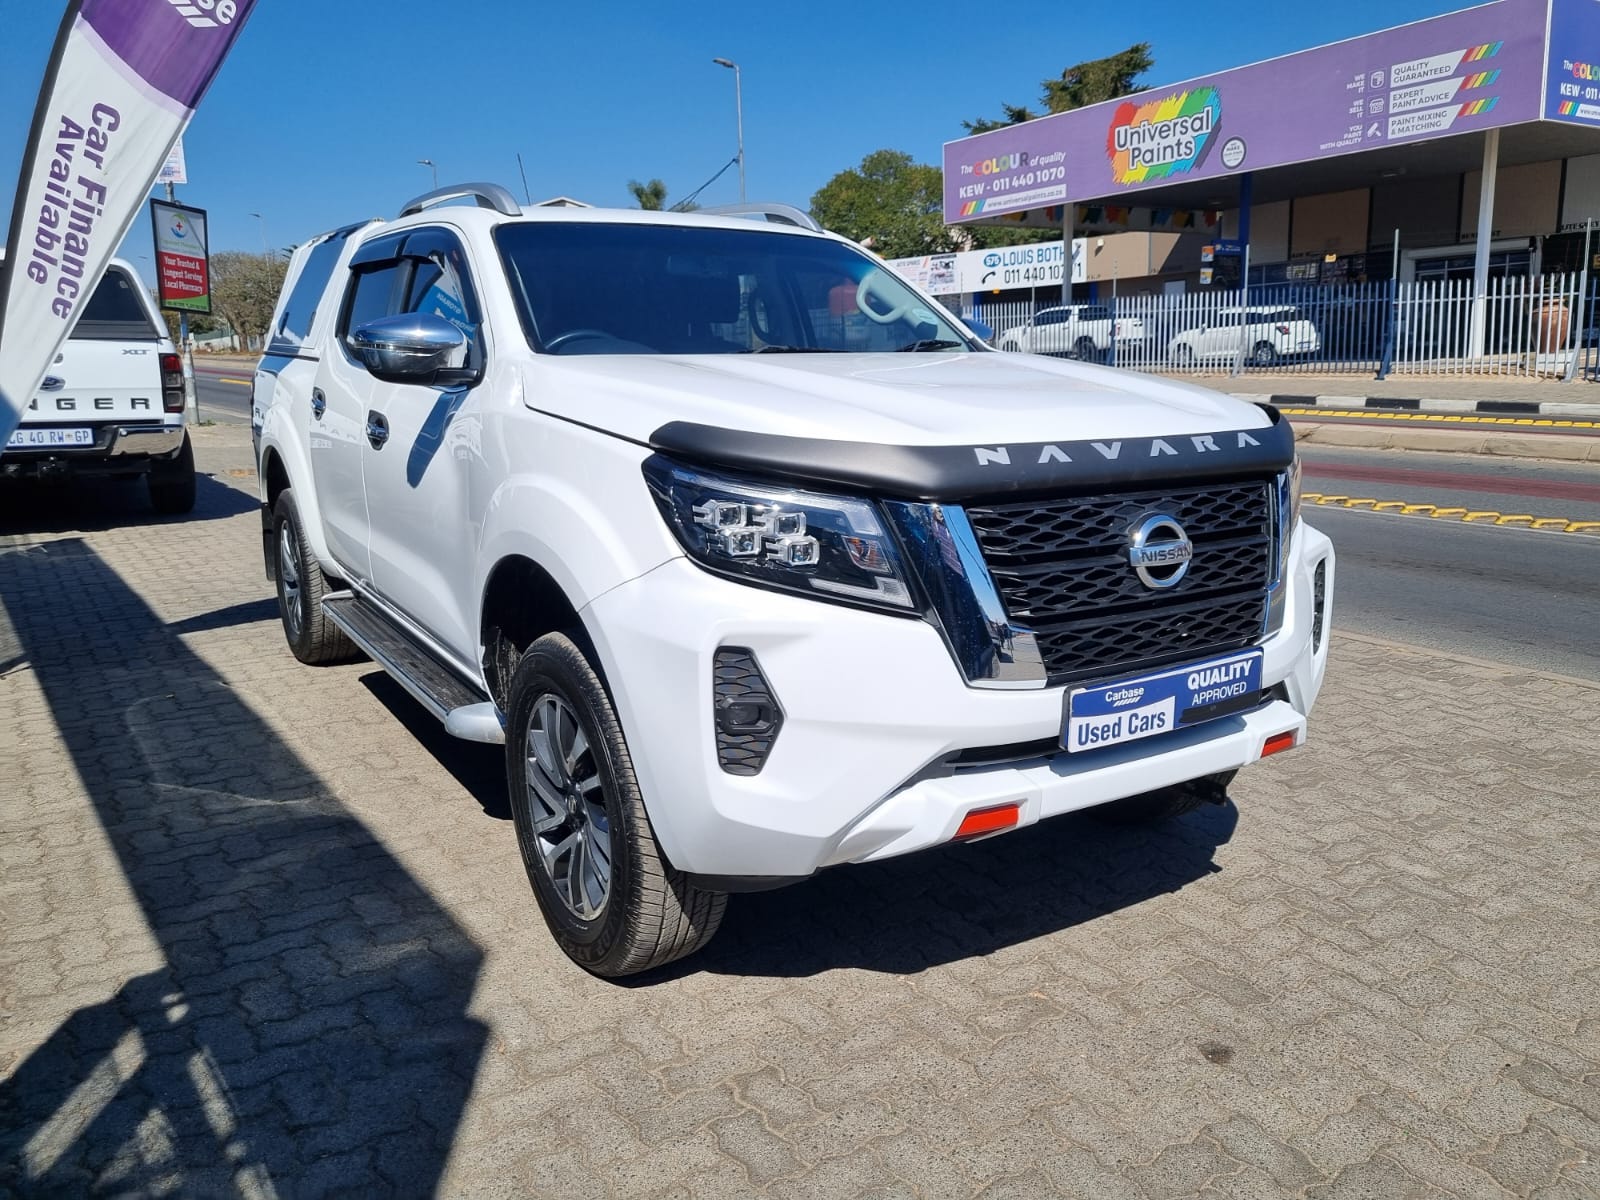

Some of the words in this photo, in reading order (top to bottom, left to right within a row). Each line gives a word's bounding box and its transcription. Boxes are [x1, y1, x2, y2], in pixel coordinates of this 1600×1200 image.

[1393, 61, 1430, 76] QUALITY
[1393, 65, 1451, 84] GUARANTEED
[1563, 60, 1573, 71] The
[1573, 62, 1600, 81] COLO
[1346, 81, 1365, 89] MAKE
[1560, 82, 1580, 97] KEW
[1585, 87, 1598, 100] 011
[1392, 99, 1416, 110] PAINT
[1418, 92, 1449, 104] ADVICE
[1393, 89, 1424, 101] EXPERT
[1348, 106, 1364, 114] SELL
[1391, 116, 1415, 127] PAINT
[1417, 111, 1447, 122] MIXING
[84, 102, 121, 170] Car
[1116, 108, 1212, 150] Universal
[1397, 121, 1441, 135] MATCHING
[1336, 137, 1362, 148] QUALITY
[1130, 138, 1194, 168] Paints
[960, 165, 973, 175] The
[973, 152, 1029, 176] COLOUR
[1030, 156, 1041, 167] of
[1040, 152, 1066, 165] quality
[959, 183, 985, 198] KEW
[992, 178, 1010, 191] 011
[1012, 173, 1034, 187] 440
[1036, 166, 1066, 183] 1070
[27, 115, 85, 285] Available
[52, 175, 107, 320] Finance
[1003, 249, 1034, 266] LOUIS
[1037, 247, 1065, 263] BOTH
[164, 256, 176, 266] Your
[176, 258, 195, 269] Trusted
[163, 267, 184, 278] Longest
[184, 271, 203, 283] Serving
[1004, 269, 1020, 284] 011
[1024, 266, 1046, 282] 440
[164, 280, 178, 289] Local
[178, 282, 203, 294] Pharmacy
[75, 430, 89, 442] GP
[974, 432, 1261, 466] NAVARA
[1140, 546, 1193, 564] NISSAN
[1187, 660, 1253, 690] QUALITY
[1105, 687, 1145, 703] Carbase
[1191, 681, 1247, 706] APPROVED
[1078, 716, 1122, 746] Used
[1128, 710, 1166, 736] Cars
